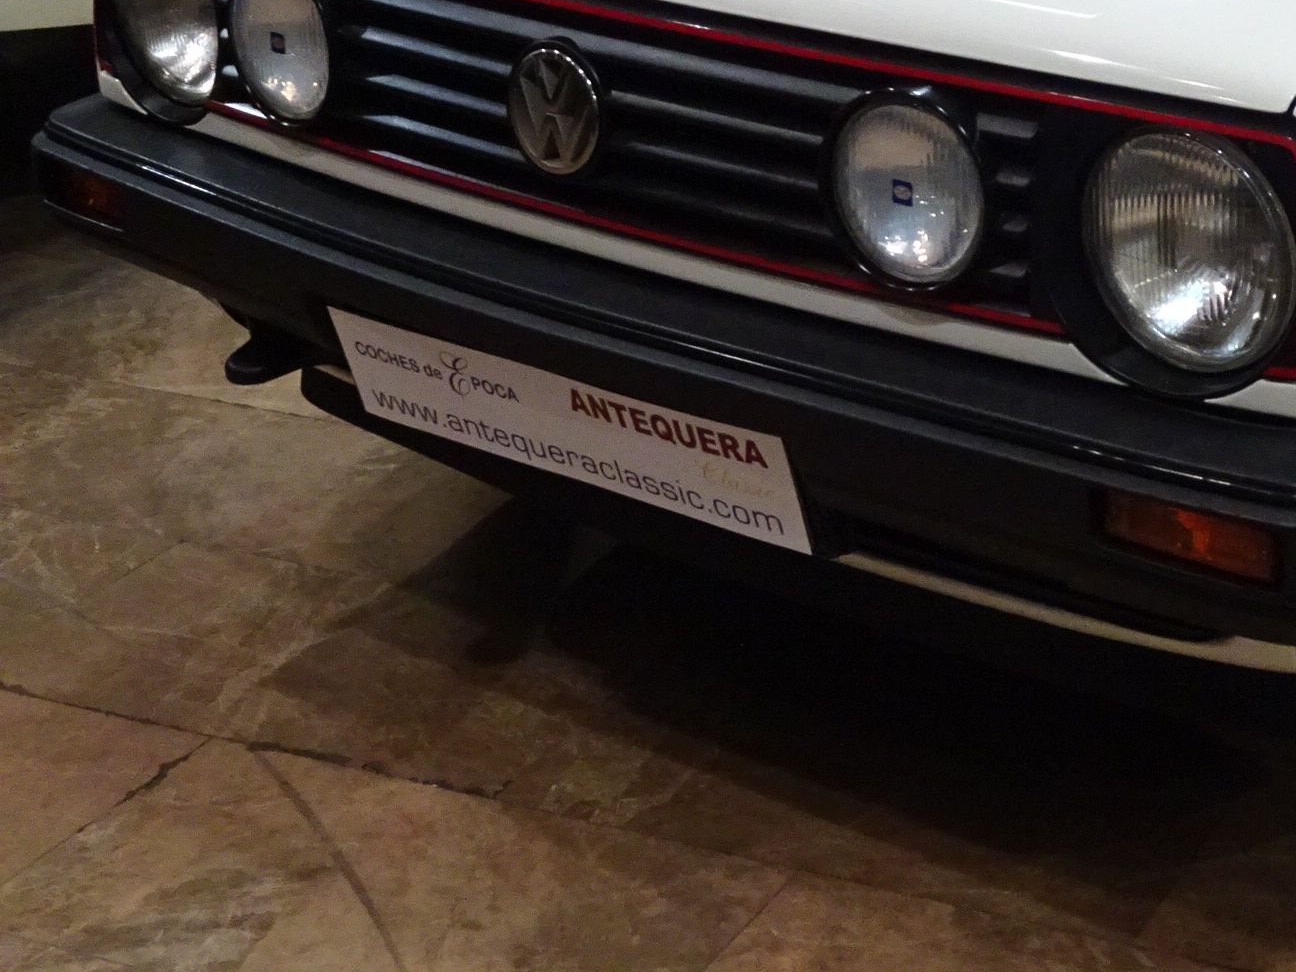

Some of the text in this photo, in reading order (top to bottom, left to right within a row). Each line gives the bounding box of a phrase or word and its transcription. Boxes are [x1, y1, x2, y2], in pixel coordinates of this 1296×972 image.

[355, 341, 420, 374] COCHES
[423, 363, 444, 380] de
[371, 388, 785, 536] www.antequeraclassic.com
[570, 388, 769, 470] ANTEQUERA
